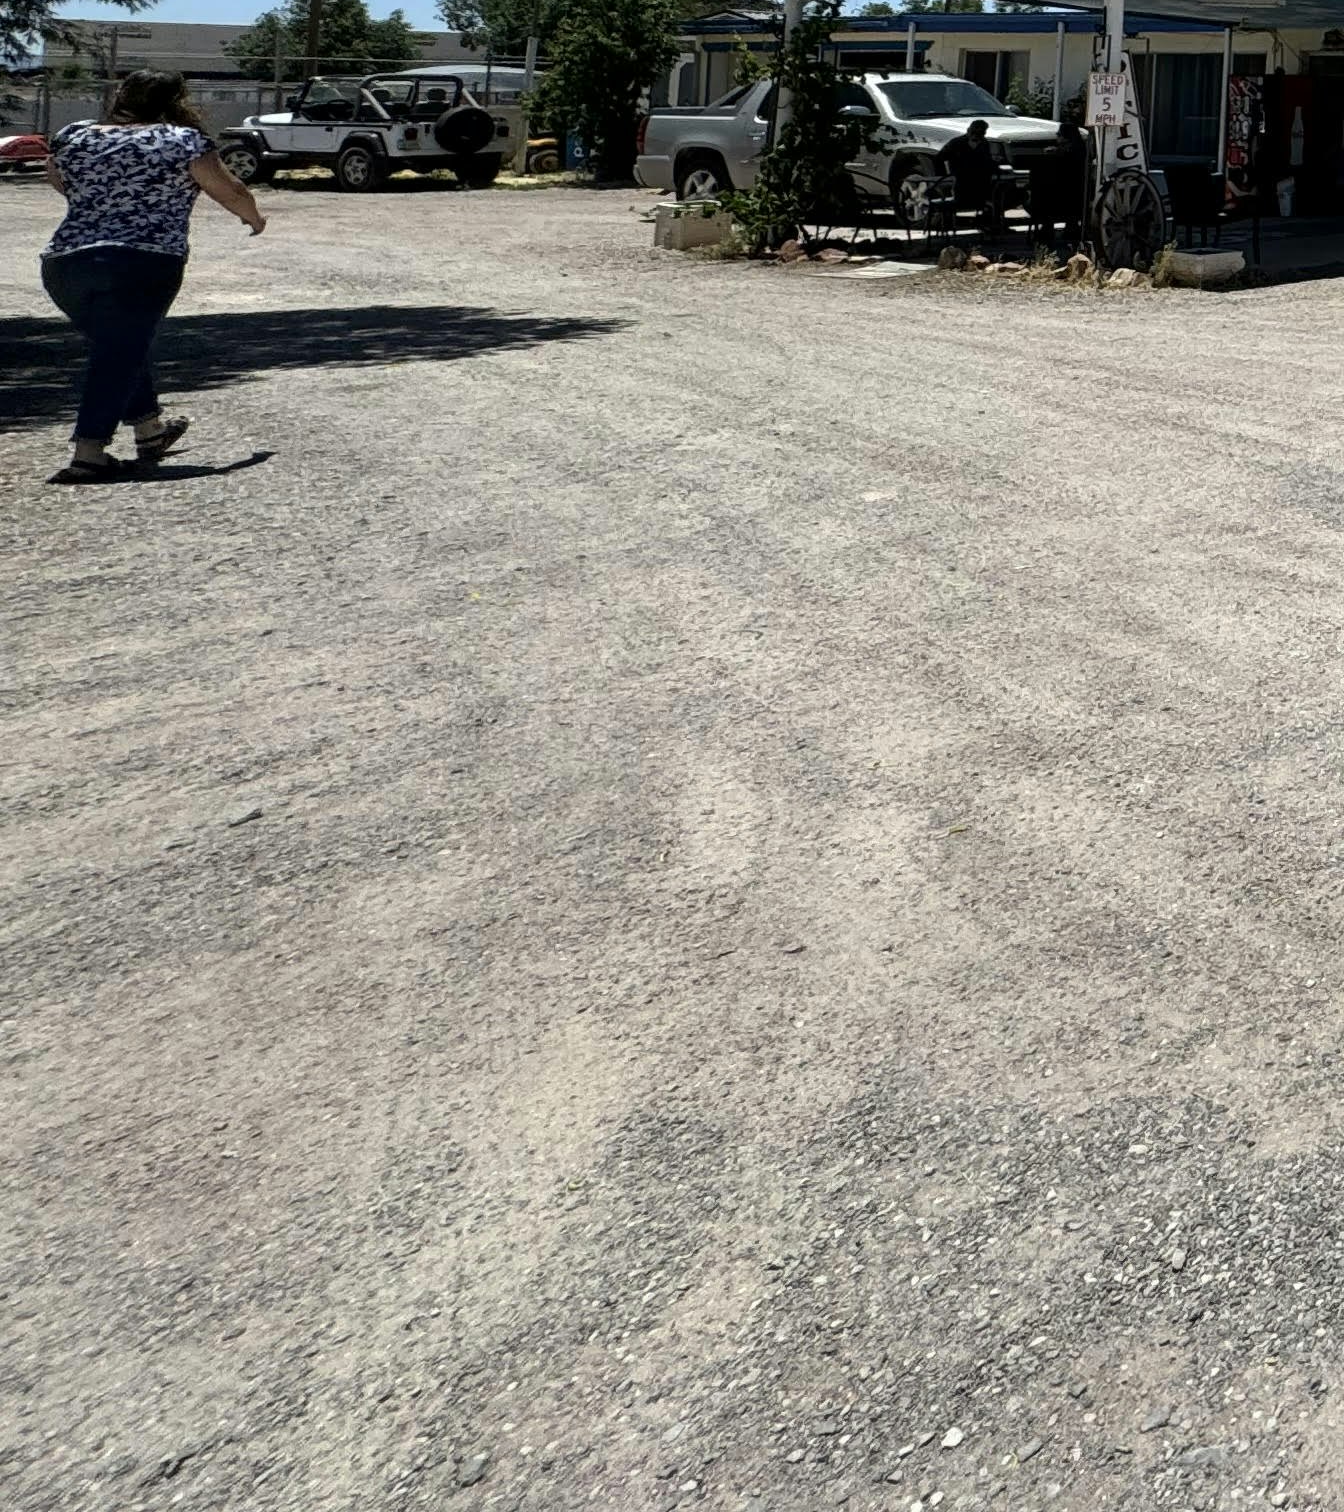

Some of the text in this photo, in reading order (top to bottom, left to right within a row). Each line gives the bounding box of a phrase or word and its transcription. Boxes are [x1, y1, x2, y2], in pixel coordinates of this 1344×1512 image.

[1092, 74, 1125, 86] SPEED
[1095, 85, 1120, 96] LIMIT
[1102, 97, 1111, 112] 5
[1095, 113, 1116, 124] MPH
